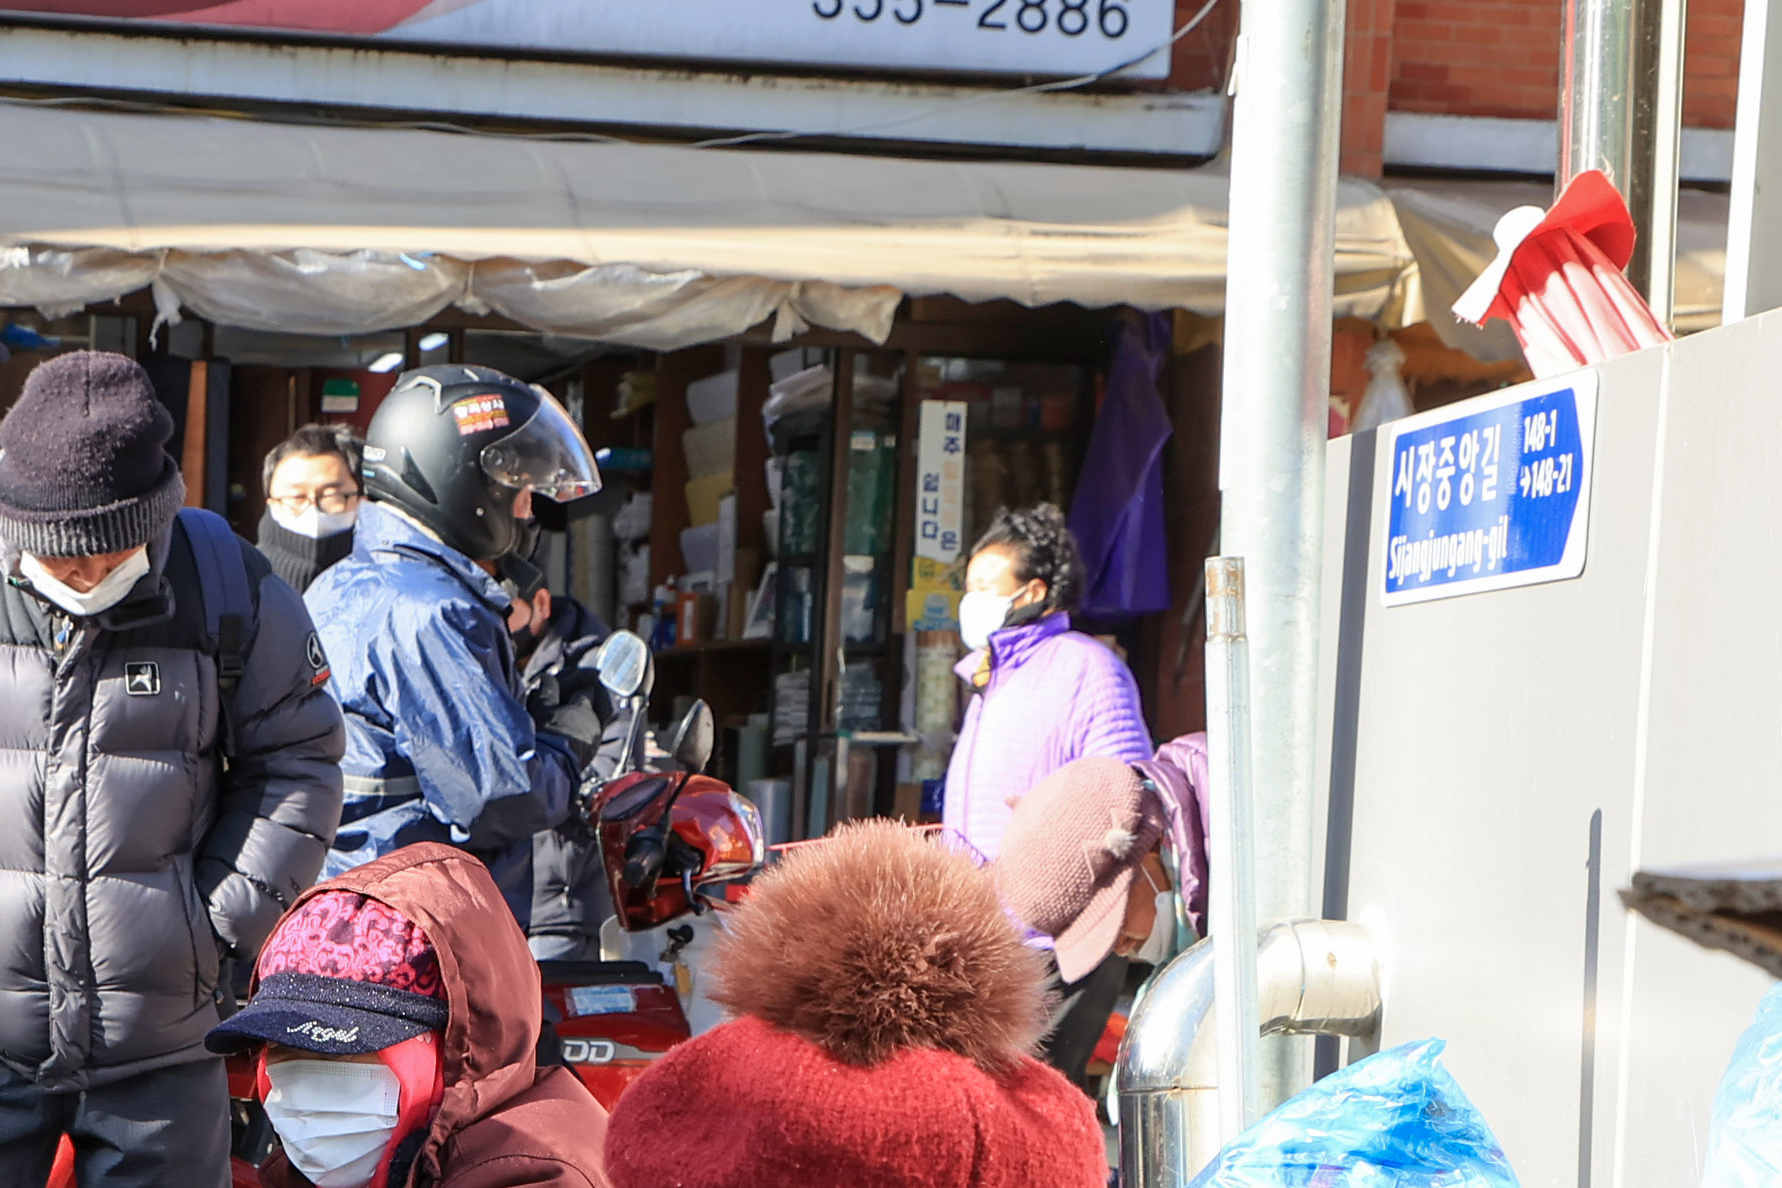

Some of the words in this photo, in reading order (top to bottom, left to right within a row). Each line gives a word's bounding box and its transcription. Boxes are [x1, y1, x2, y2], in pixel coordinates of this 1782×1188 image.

[1523, 408, 1558, 454] 148-1
[1395, 423, 1501, 515] 시장중앙길
[1388, 515, 1508, 586] Sijangjungang-gil
